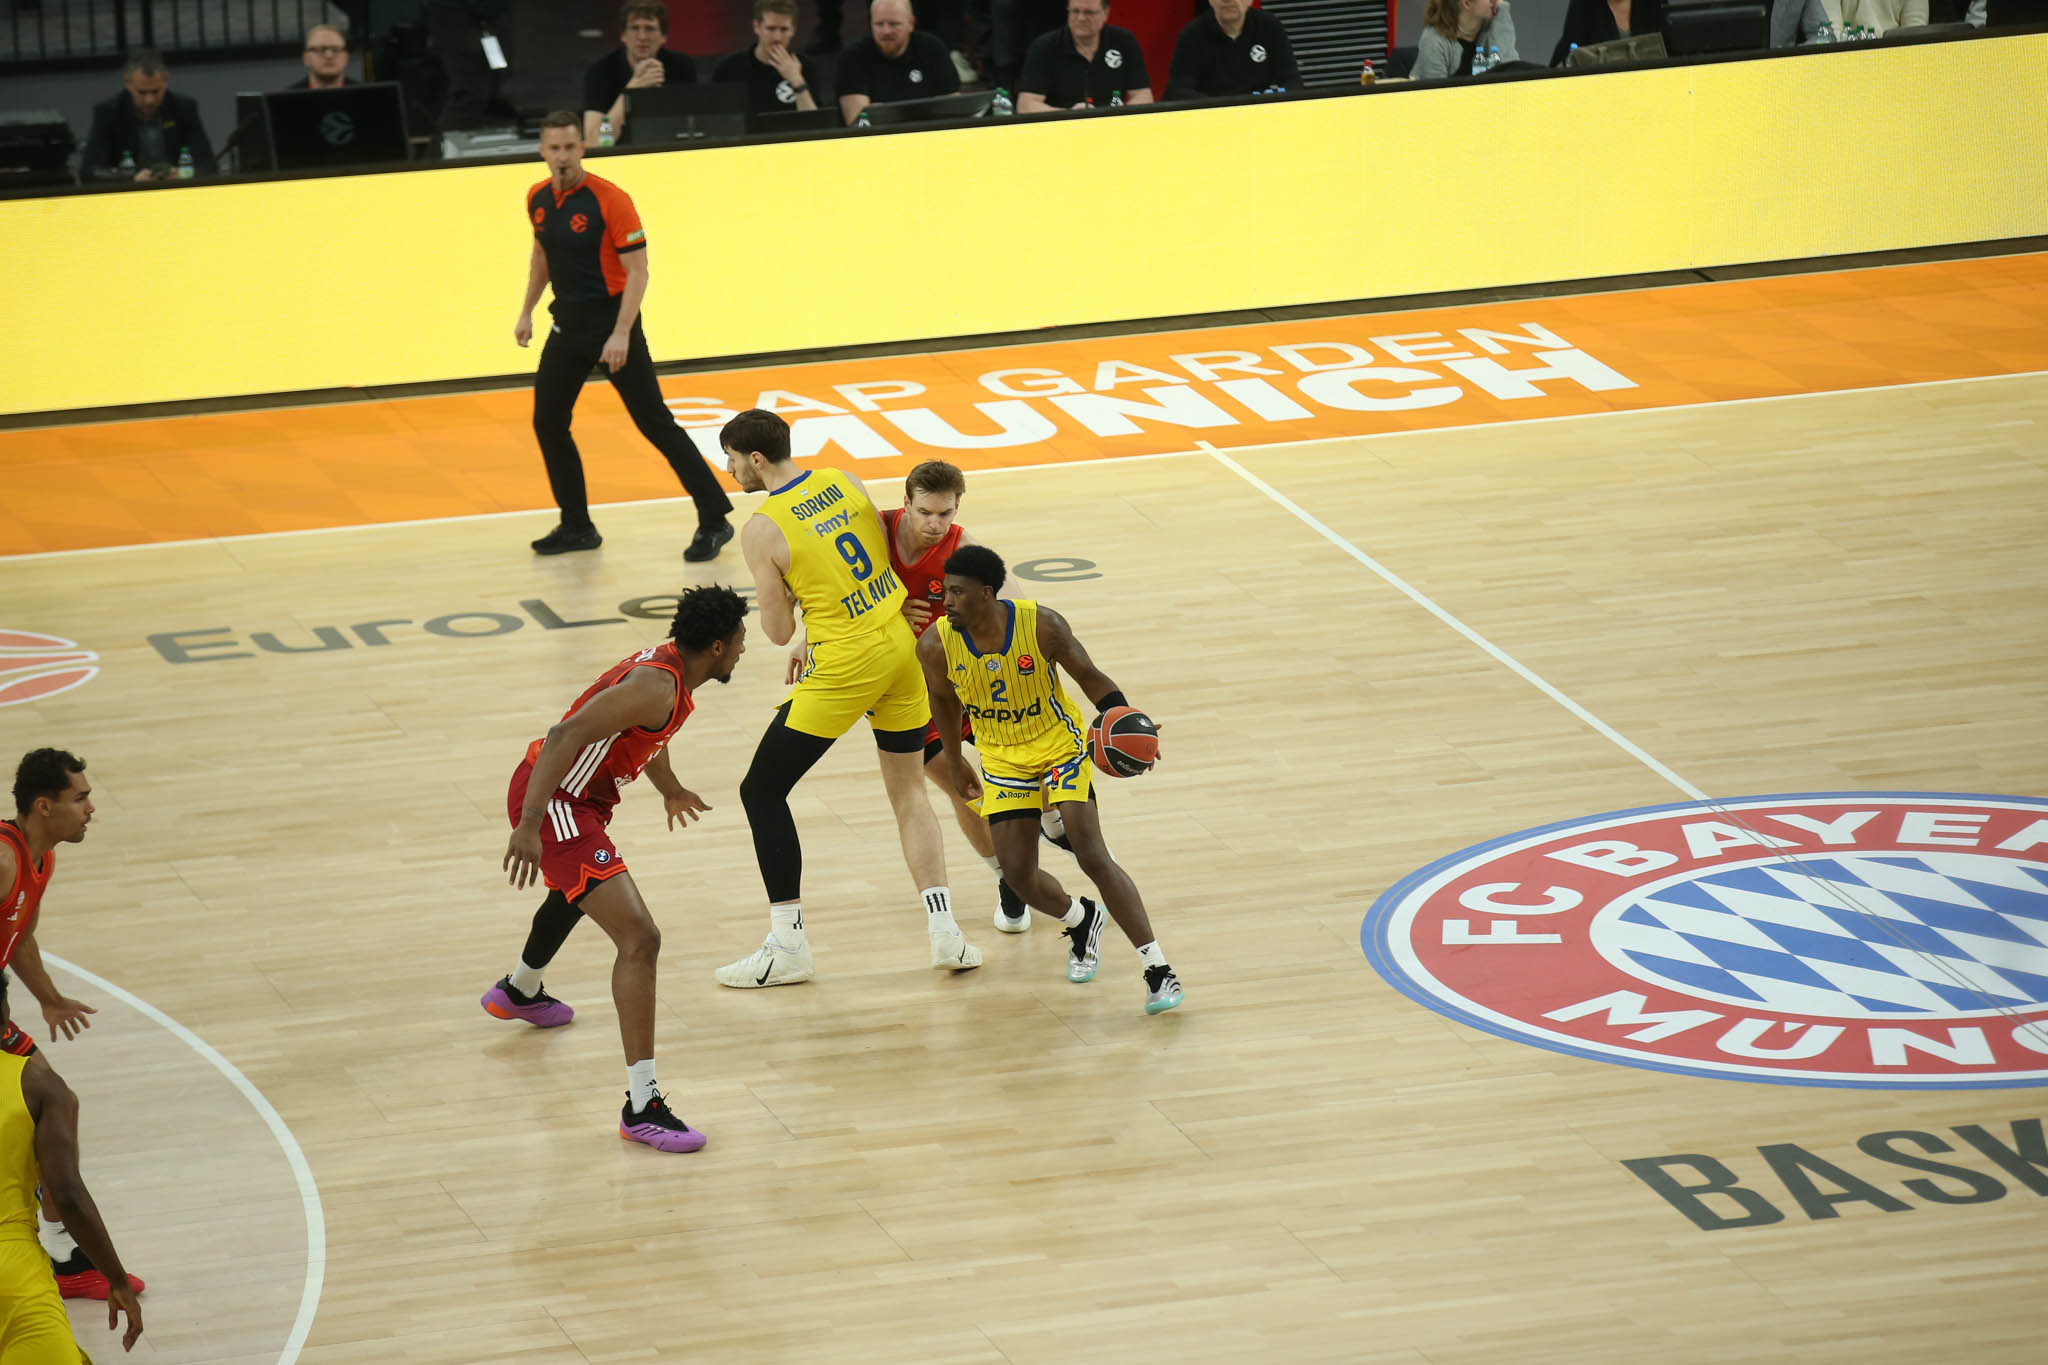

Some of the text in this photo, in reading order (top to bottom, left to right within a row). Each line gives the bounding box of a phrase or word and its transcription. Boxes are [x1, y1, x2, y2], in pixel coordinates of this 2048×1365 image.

[663, 322, 1575, 427] SAP GARDEN
[680, 348, 1640, 472] MUNICH
[790, 483, 845, 521] SORKIN
[834, 531, 873, 582] 9
[840, 566, 898, 620] TEL AVIV
[965, 696, 1042, 724] Rapyd
[989, 679, 1009, 703] 2
[1007, 790, 1031, 800] Rapyd
[1060, 762, 1081, 790] 2
[1441, 882, 1585, 946] FC
[1619, 1117, 2048, 1232] BASK
